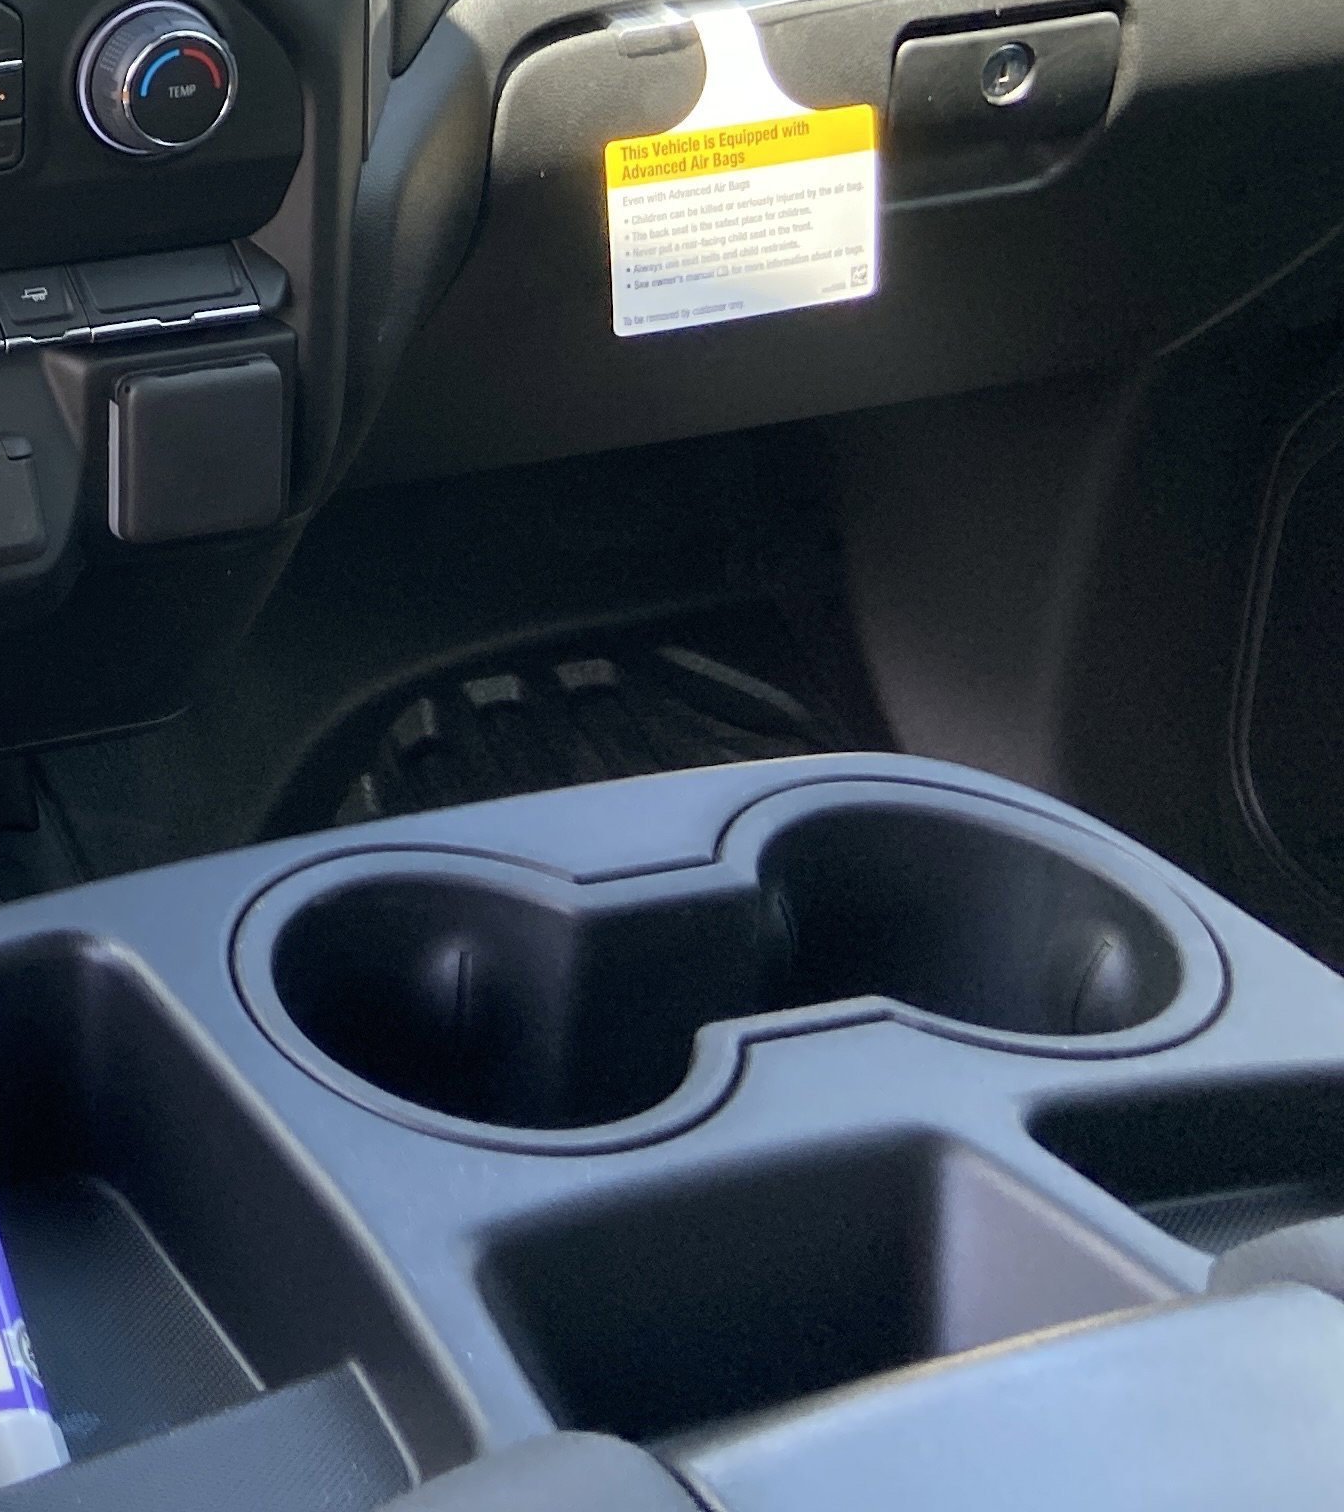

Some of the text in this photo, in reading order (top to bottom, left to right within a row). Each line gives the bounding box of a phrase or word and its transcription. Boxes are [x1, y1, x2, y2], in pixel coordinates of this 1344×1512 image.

[168, 83, 196, 100] TEMP
[620, 120, 810, 161] This Vehicle is Equipped with
[622, 151, 745, 181] Advanced Air Bags
[623, 180, 750, 207] Even with Advanced Air Bags
